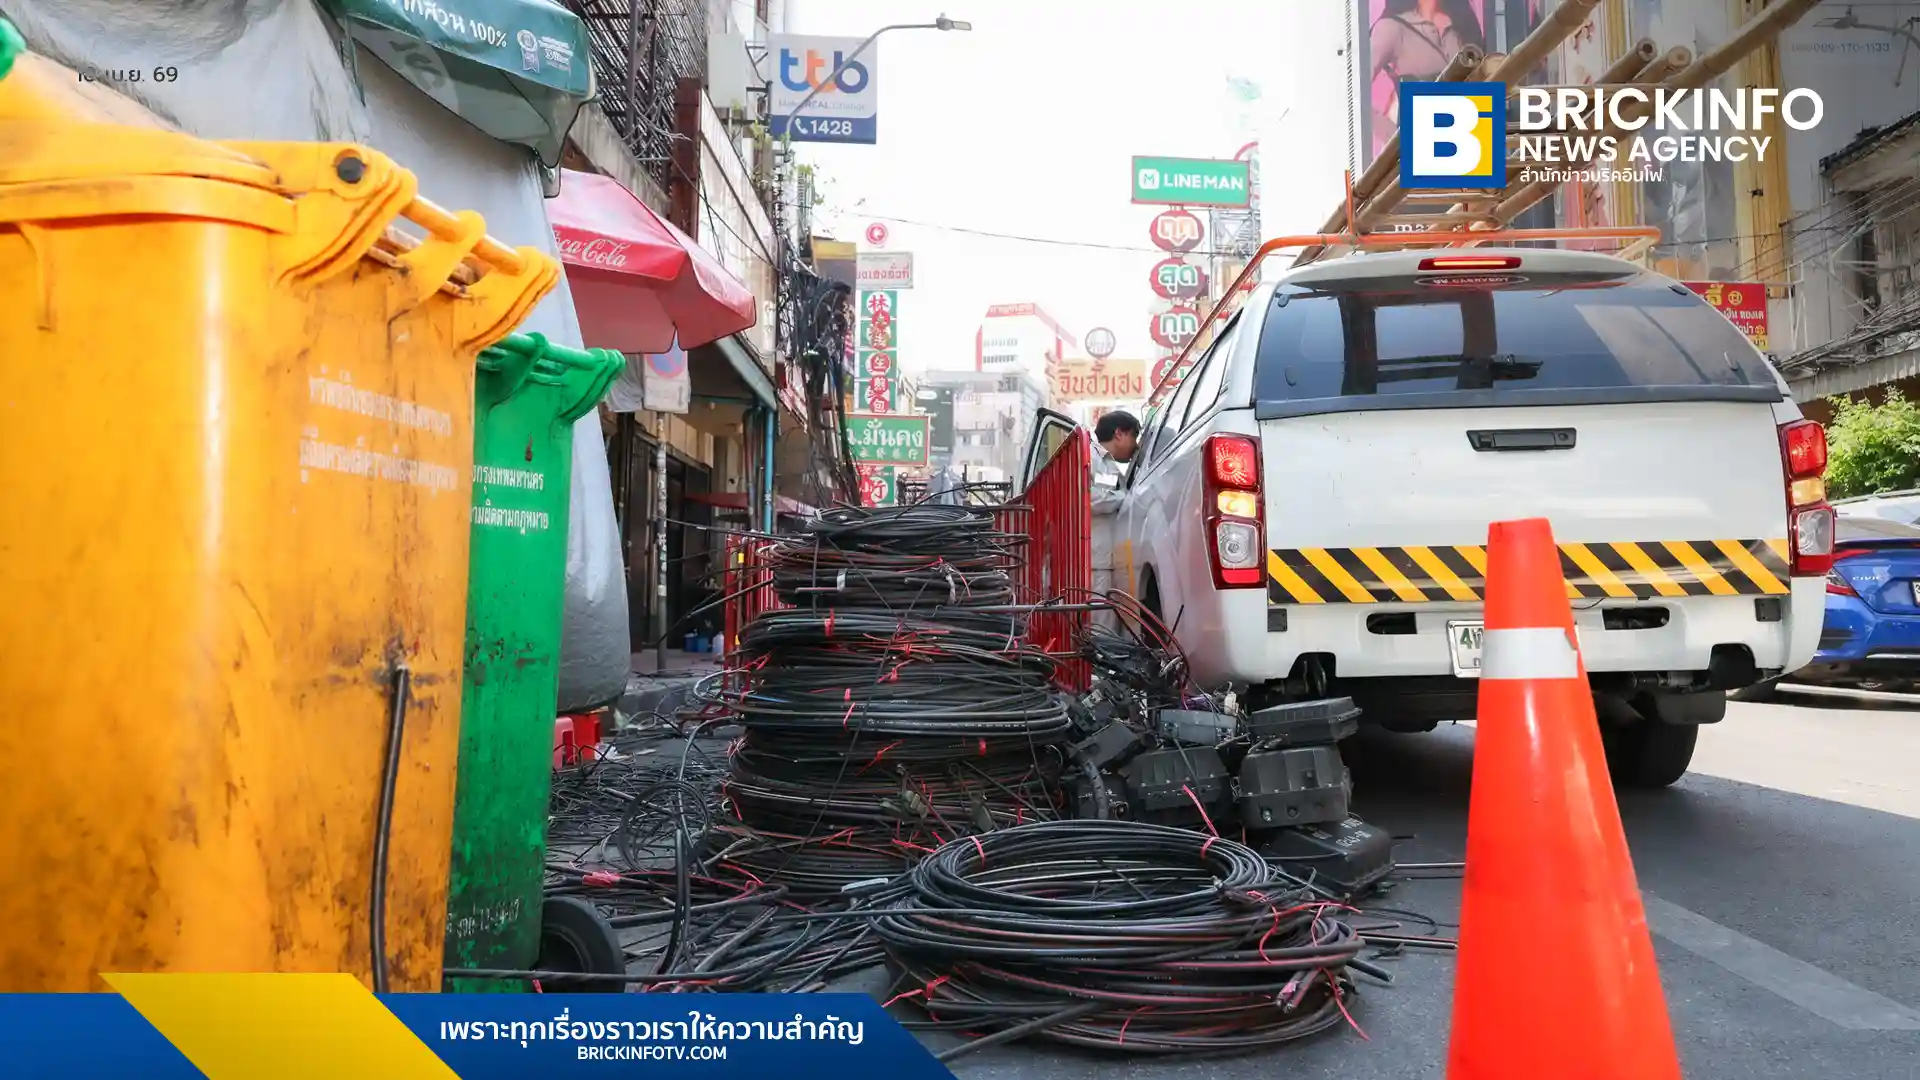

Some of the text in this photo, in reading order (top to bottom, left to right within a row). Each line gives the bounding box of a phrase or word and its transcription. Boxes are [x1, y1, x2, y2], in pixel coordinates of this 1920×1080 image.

[469, 19, 508, 48] 100%
[780, 48, 869, 94] ttb
[810, 119, 852, 135] 1428
[1159, 264, 1198, 294] สุด
